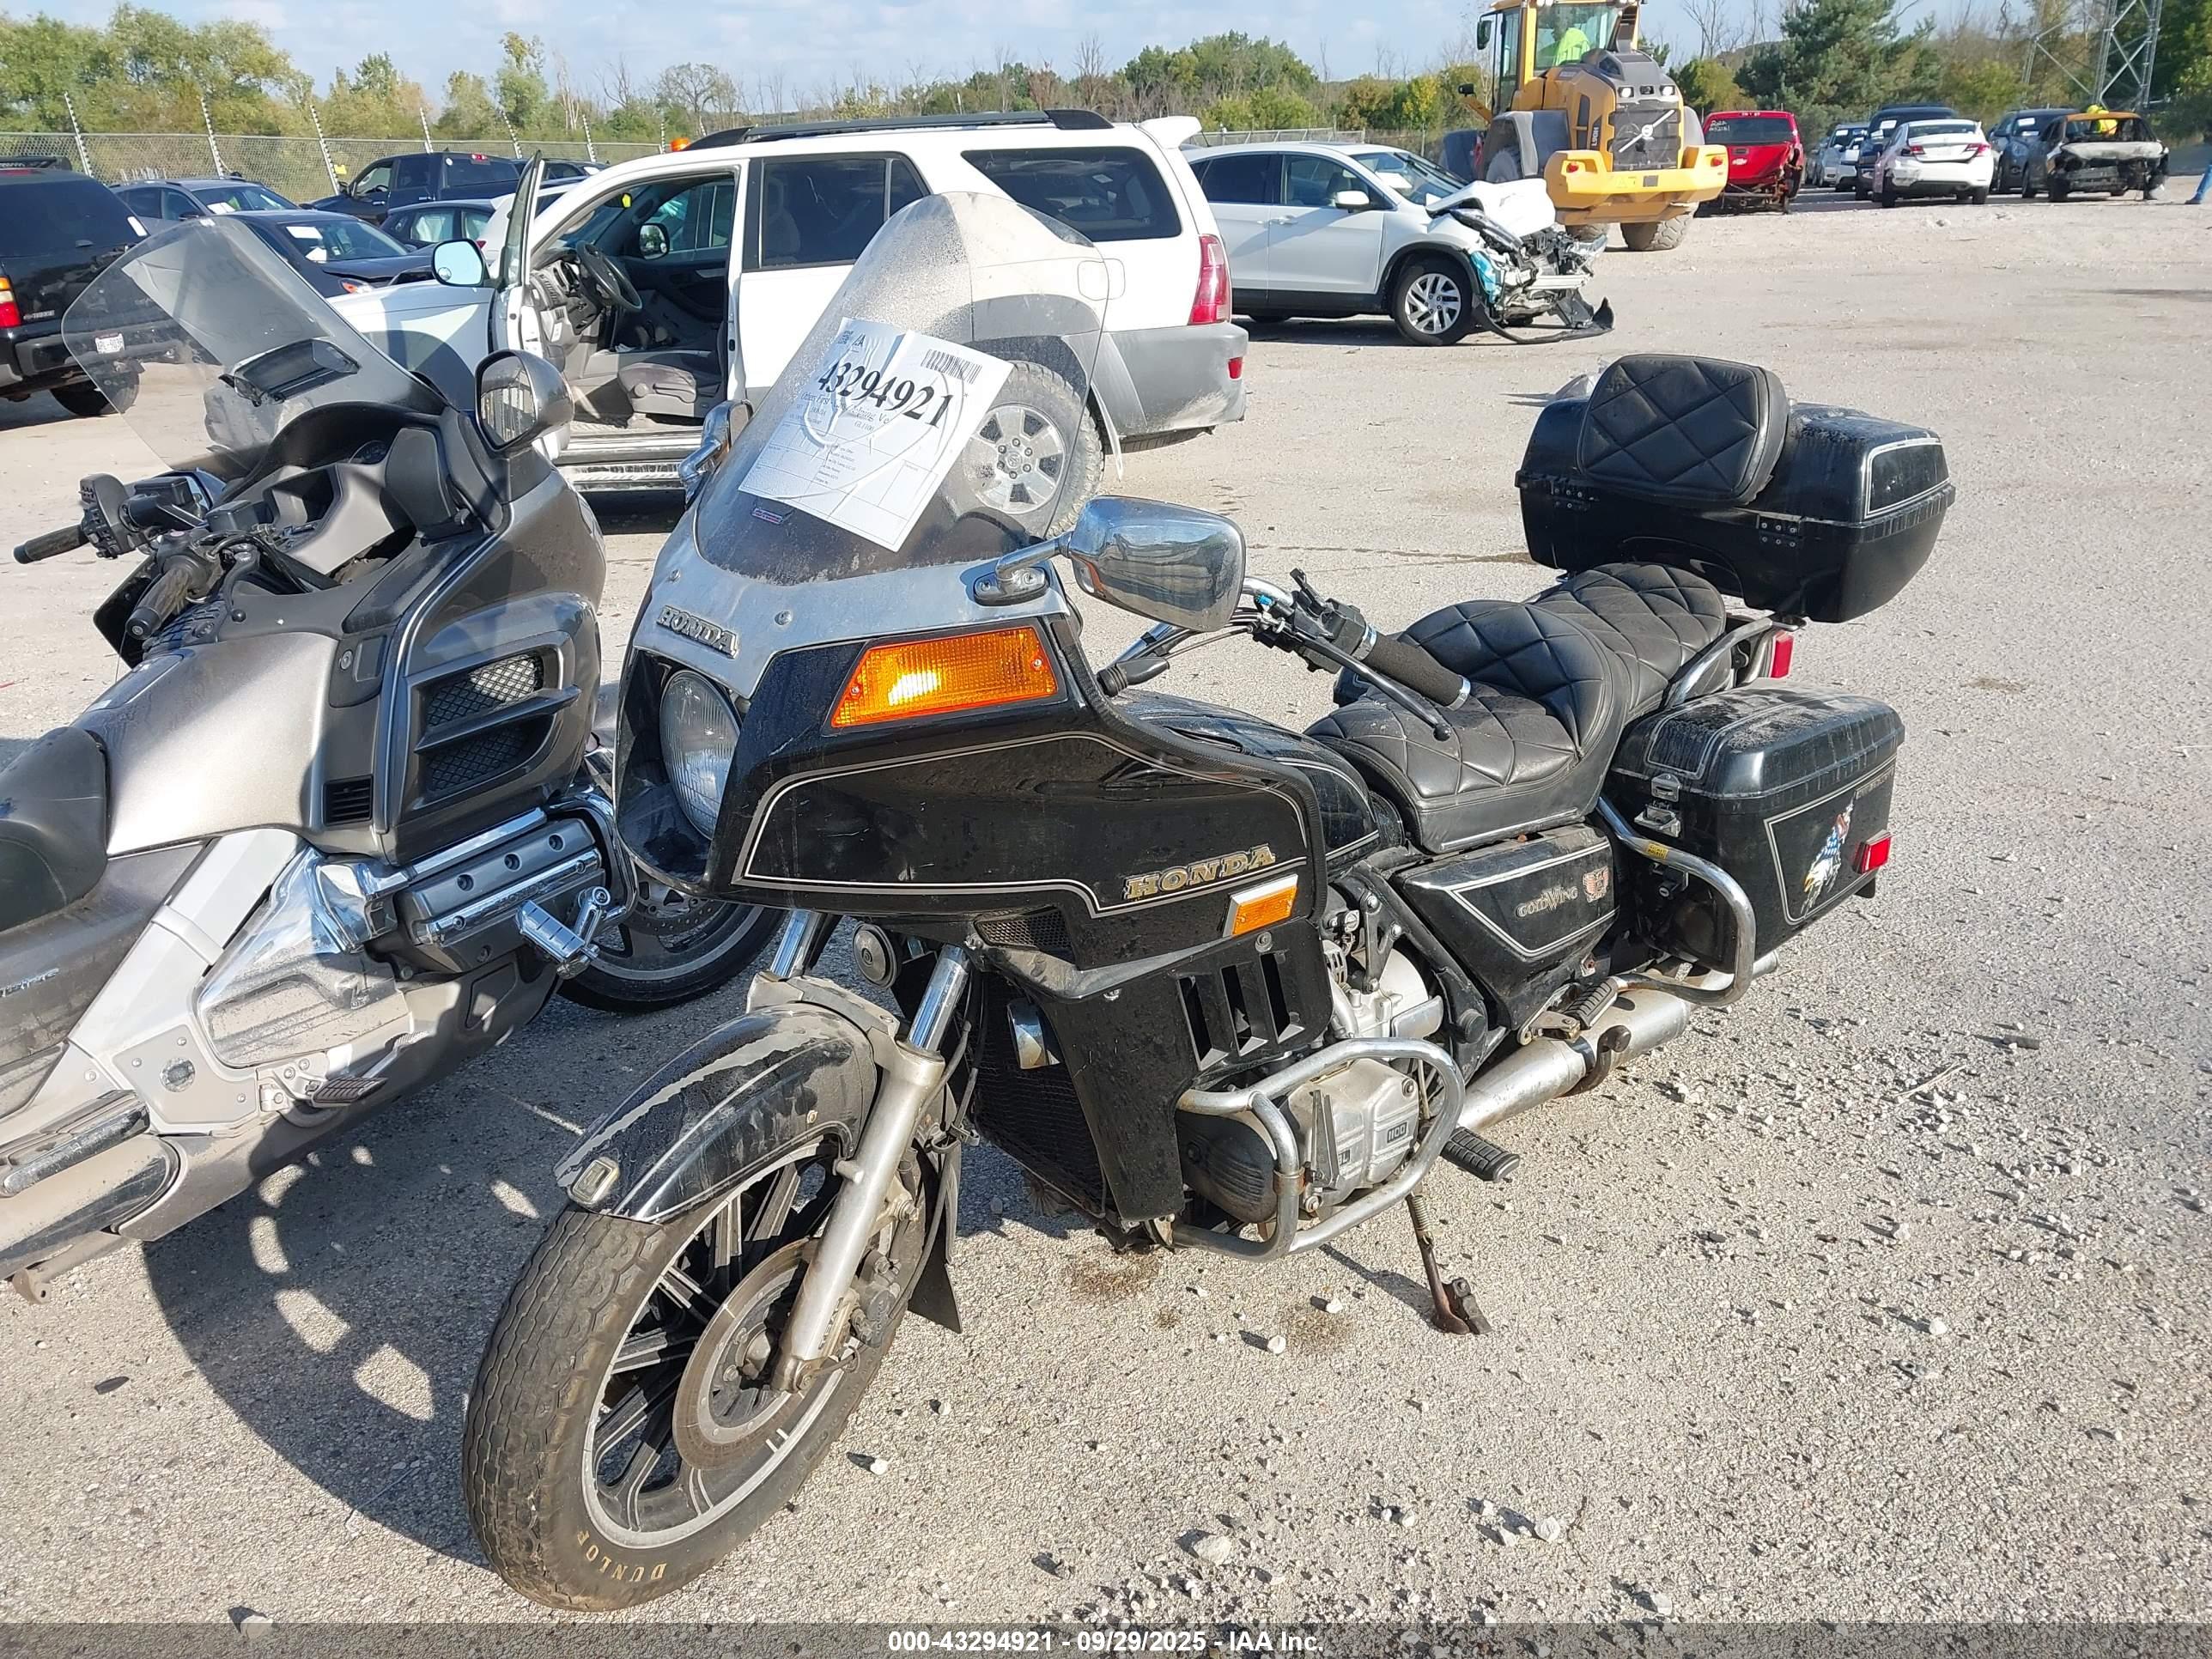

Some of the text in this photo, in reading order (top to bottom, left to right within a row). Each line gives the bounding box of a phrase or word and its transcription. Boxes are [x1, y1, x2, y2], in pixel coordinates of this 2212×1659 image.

[818, 361, 953, 428] 43294921
[656, 605, 738, 659] HONDA
[1123, 845, 1277, 899] HONDA
[1388, 1123, 1406, 1141] 1100
[577, 1530, 667, 1582] DUNLOP
